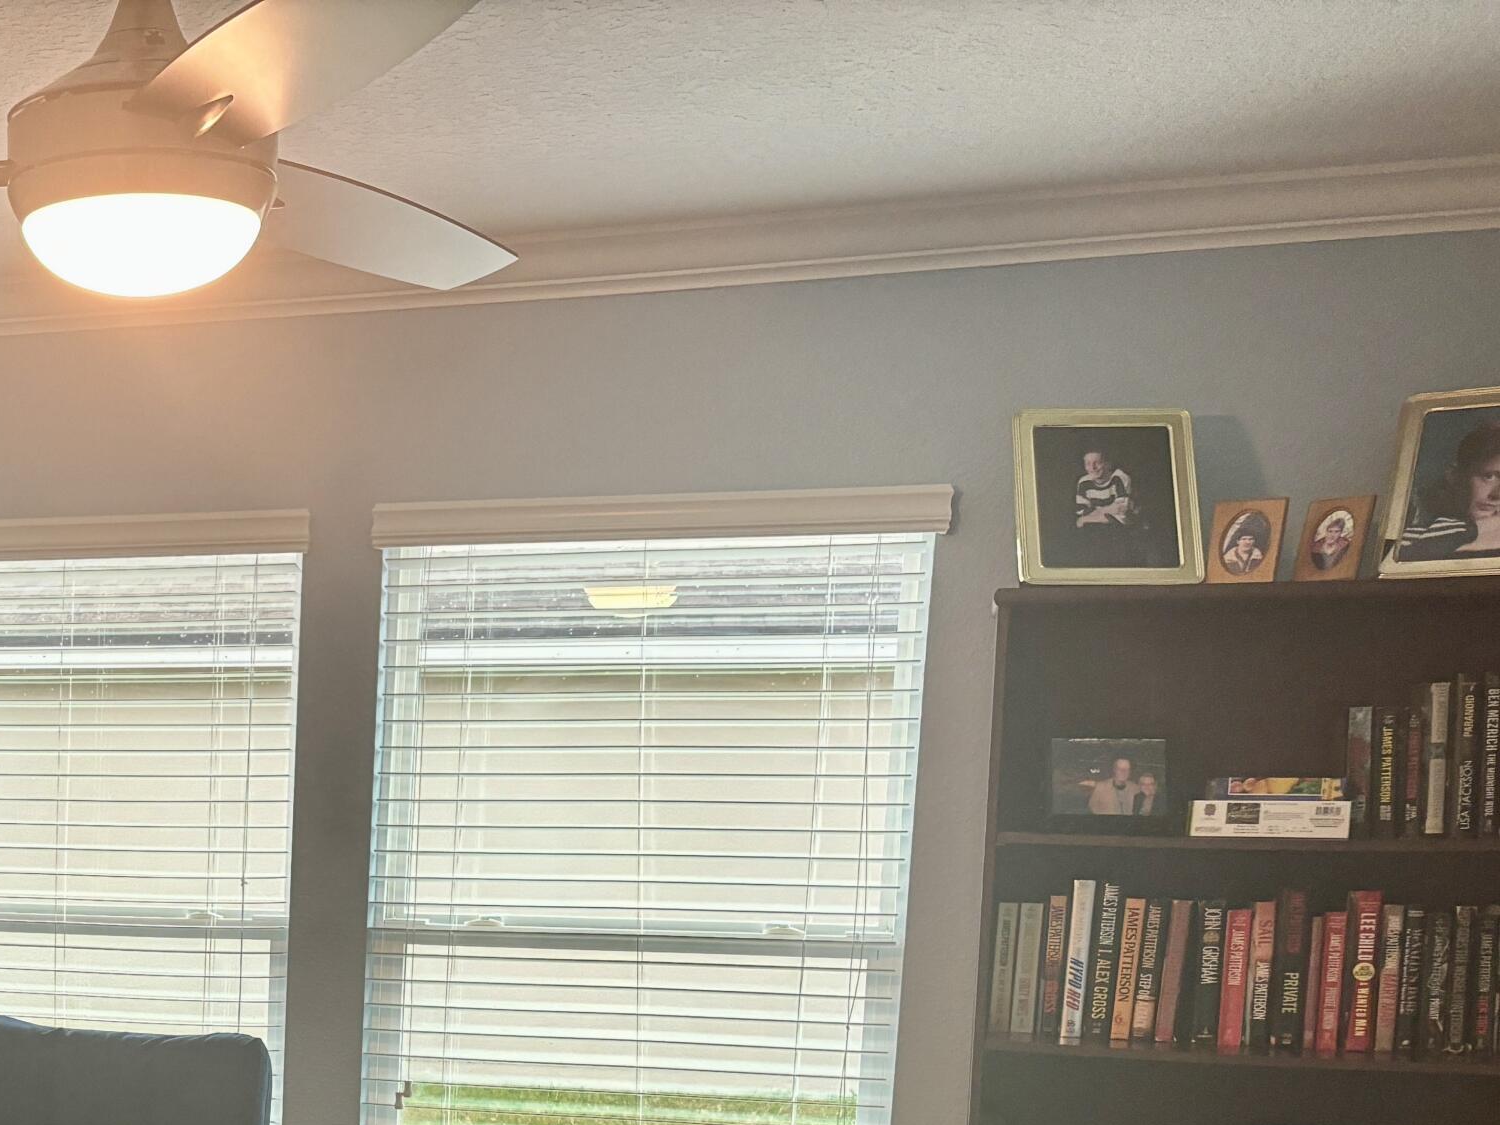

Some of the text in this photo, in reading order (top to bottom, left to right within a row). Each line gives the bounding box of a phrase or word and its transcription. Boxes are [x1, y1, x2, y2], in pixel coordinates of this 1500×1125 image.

[1463, 694, 1476, 737] PARANOID
[1486, 688, 1500, 707] BEN
[1381, 726, 1394, 755] JAMES
[1485, 709, 1500, 751] MEZRICH
[1380, 757, 1393, 803] PATTERSON
[1460, 760, 1473, 830] LISA JACKSON
[1050, 905, 1065, 928] JAMES
[1099, 882, 1119, 945] JAMES PATTERSON
[1145, 904, 1161, 929] JAMES
[1047, 928, 1063, 967] PATTERSON
[1141, 928, 1158, 968] PATTERSON
[1200, 907, 1222, 985] JOHN GRISHAM
[1257, 919, 1274, 948] SAIL
[1357, 911, 1377, 961] LEE CHILD
[1068, 957, 1085, 990] NYPD
[1094, 958, 1111, 983] ALEX
[1118, 907, 1141, 1003] JAMES PATTERSON
[1227, 928, 1245, 986] JAMES PATTERSON
[1066, 989, 1081, 1012] RED
[1139, 973, 1152, 989] STEP
[1252, 961, 1271, 1021] JAMES PATTERSON
[1281, 972, 1300, 1014] PRIVATE
[1091, 985, 1109, 1020] CROSS
[1355, 987, 1370, 1018] WANTED
[1353, 1018, 1368, 1037] MAN
